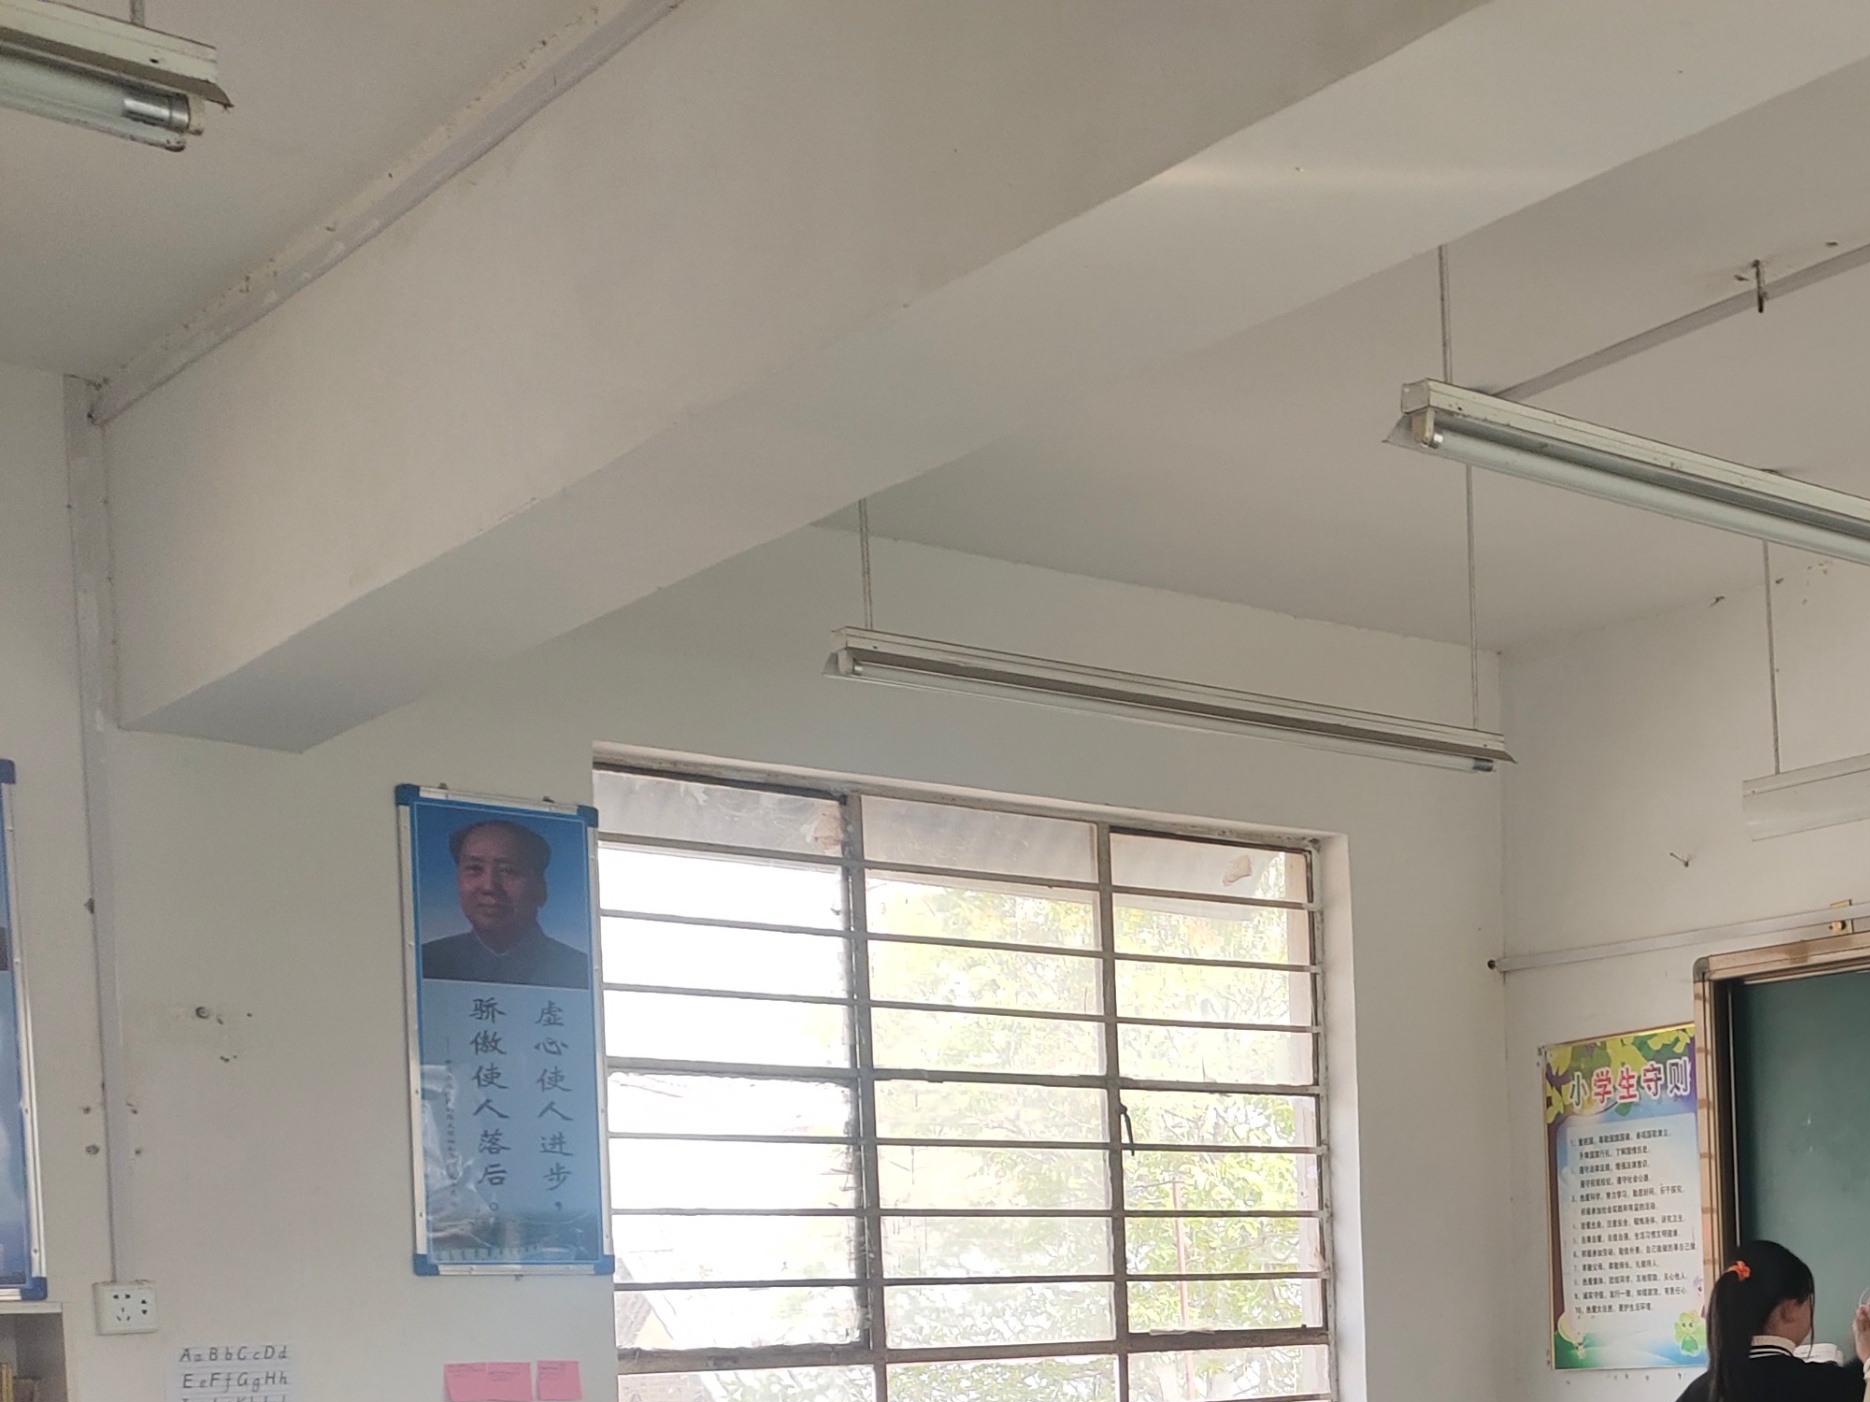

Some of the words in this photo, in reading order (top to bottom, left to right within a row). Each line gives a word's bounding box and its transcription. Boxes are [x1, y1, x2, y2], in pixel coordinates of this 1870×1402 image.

[1570, 1059, 1690, 1107] 小学生守则
